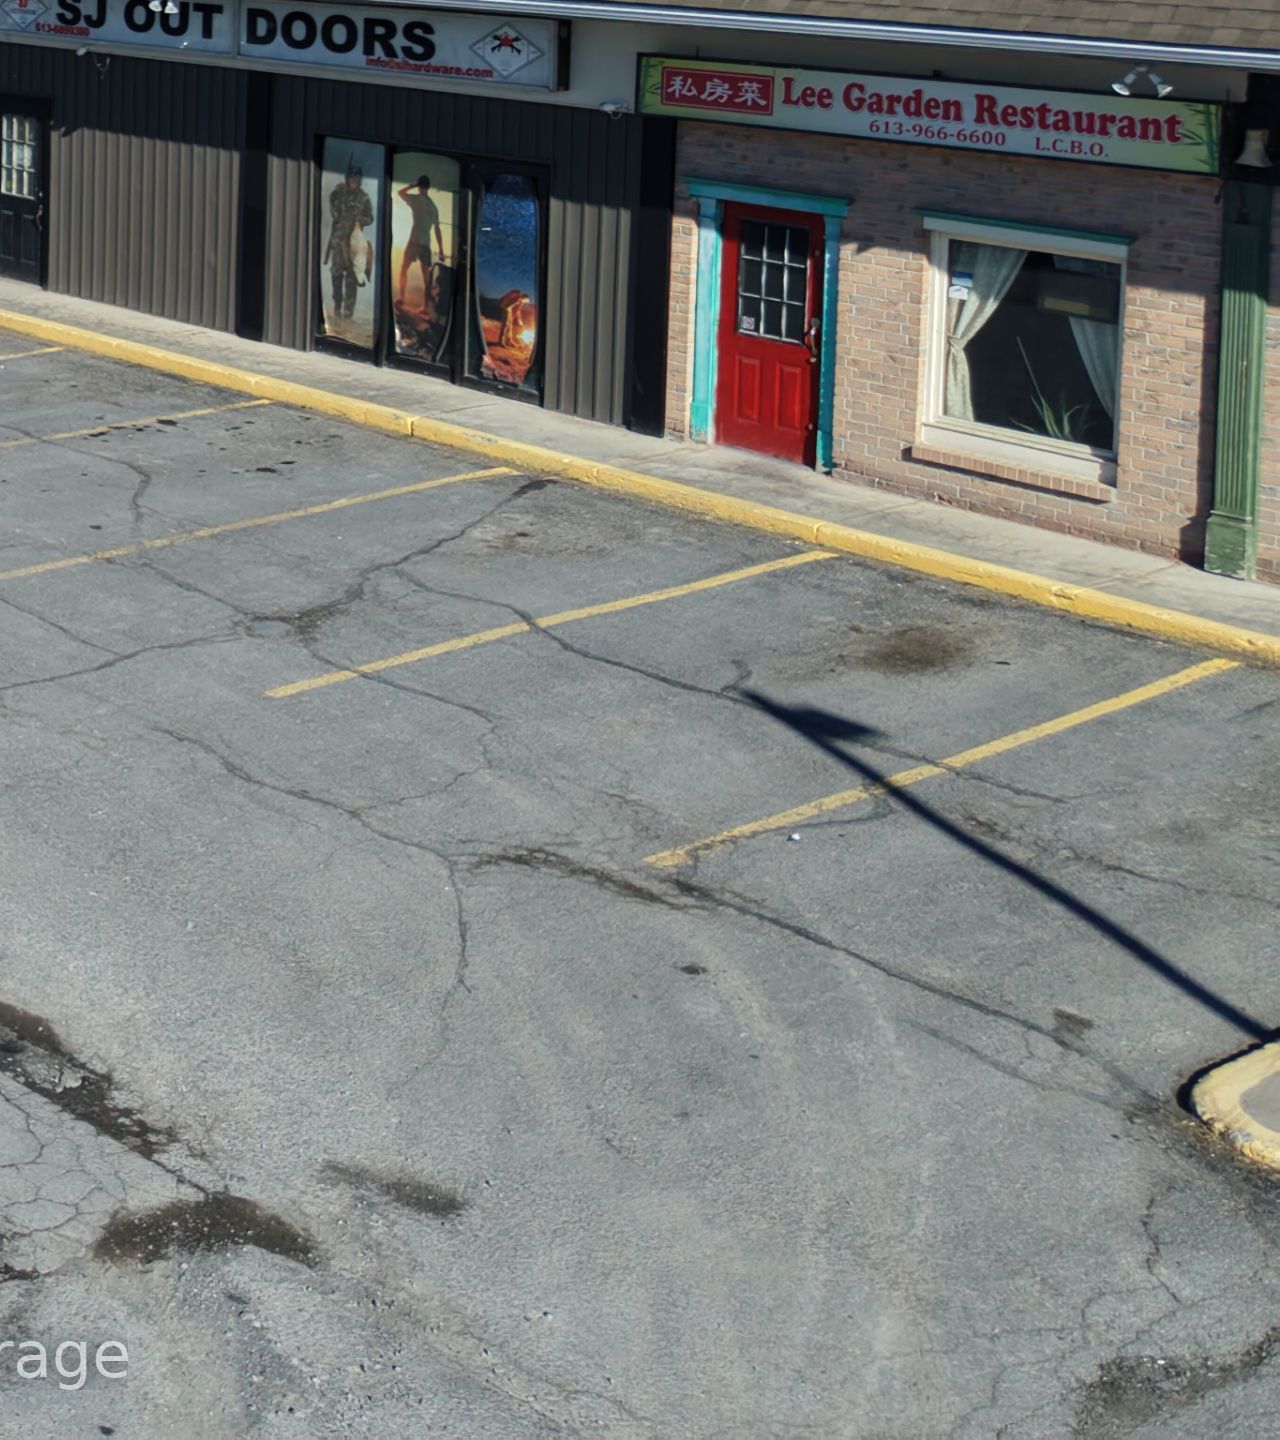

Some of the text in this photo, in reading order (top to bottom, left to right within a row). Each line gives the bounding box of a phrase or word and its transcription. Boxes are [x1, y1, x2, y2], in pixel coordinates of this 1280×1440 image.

[246, 8, 436, 61] DOORS
[666, 75, 767, 106] 私房菜
[782, 76, 1182, 144] Lee Garden Restaurant
[869, 120, 1109, 159] 613-966-6600 L.C.B.O.
